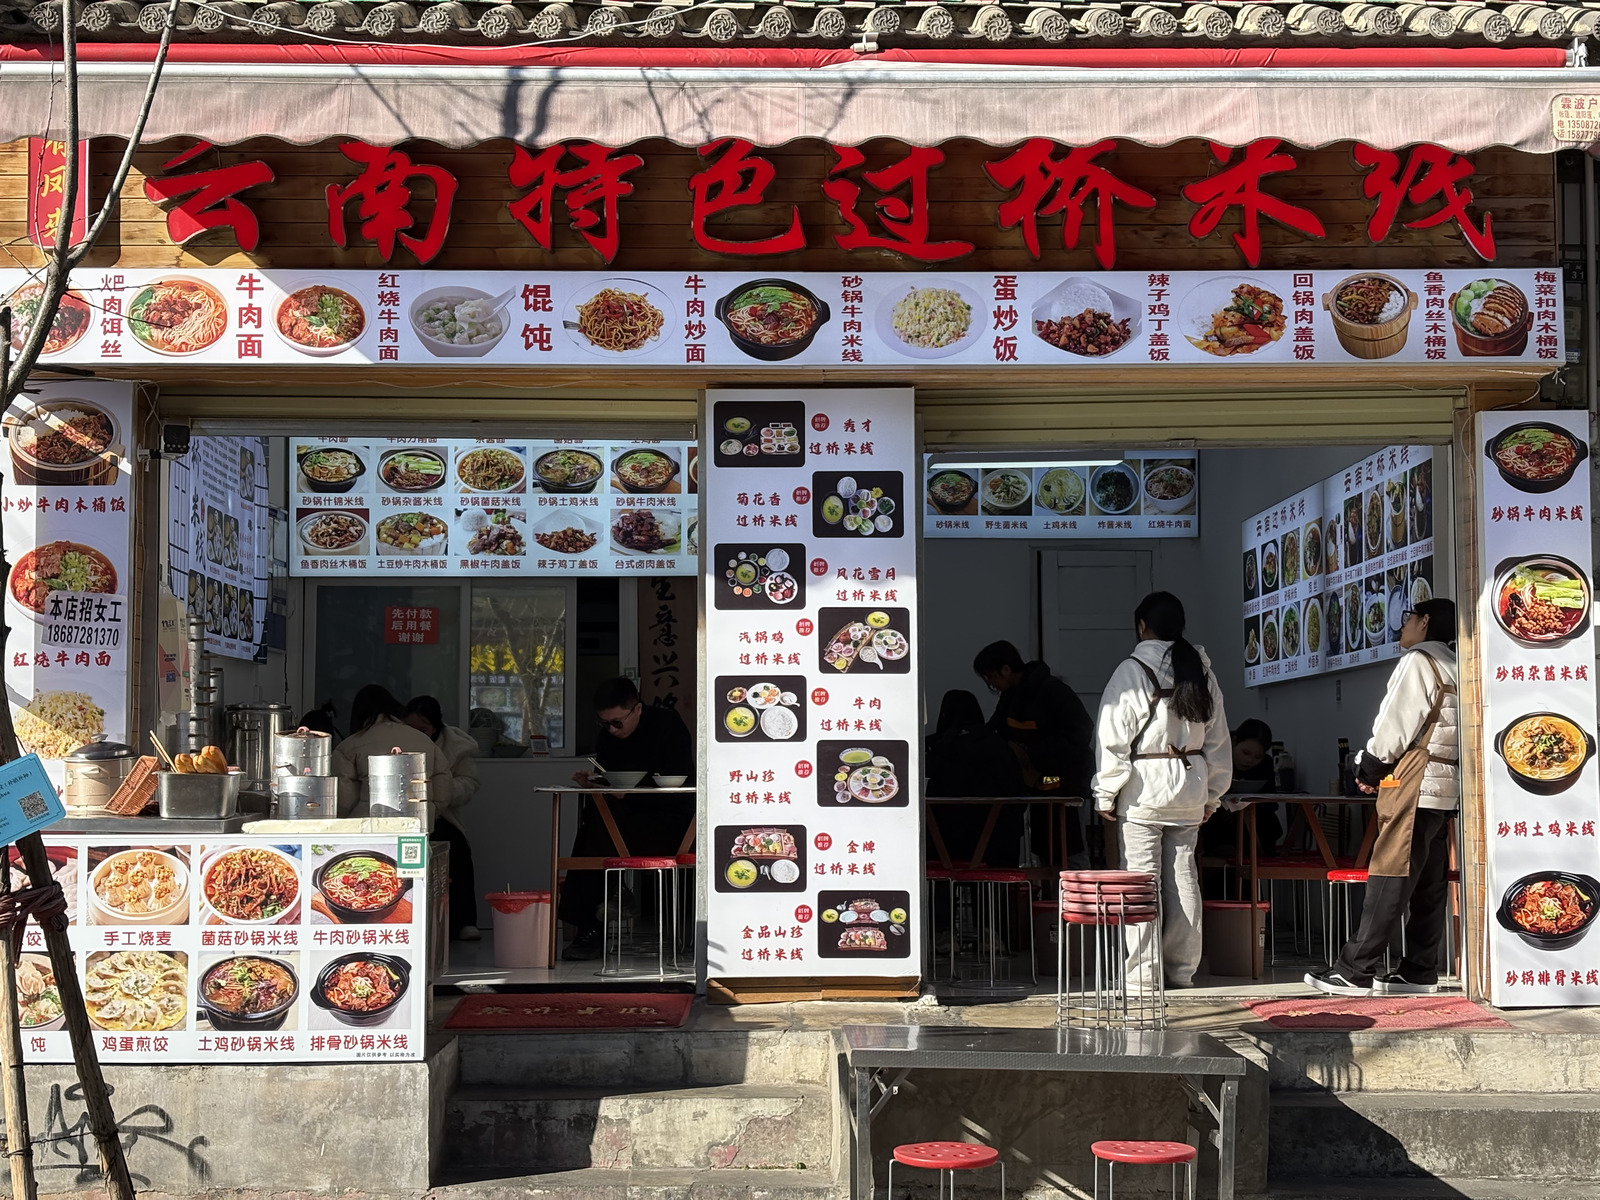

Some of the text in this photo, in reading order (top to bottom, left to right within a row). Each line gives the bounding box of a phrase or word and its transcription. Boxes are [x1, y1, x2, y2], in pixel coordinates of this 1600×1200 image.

[143, 138, 1497, 269] 云南特色过桥米线
[235, 273, 265, 360] 牛肉面
[377, 272, 400, 362] 红烧牛肉面
[520, 284, 553, 352] 馄饨
[684, 275, 706, 363] 牛肉炒面
[841, 276, 864, 362] 砂锅牛肉米线
[993, 275, 1019, 363] 蛋炒饭
[1147, 273, 1171, 362] 辣子鸡丁盖饭
[1293, 273, 1316, 361] 回锅肉盖饭
[1423, 271, 1447, 361] 鱼香肉丝木桶饭
[1534, 271, 1559, 360] 梅菜扣肉木桶饭
[843, 418, 872, 433] 秀才
[809, 441, 874, 456] 过桥米线
[1, 496, 126, 513] 小炒牛肉木桶饭
[302, 496, 364, 506] 砂锅什锦米线
[381, 496, 443, 506] 砂锅杂酱米线
[460, 496, 521, 507] 砂锅菌菇米线
[538, 496, 599, 507] 砂锅土鸡米线
[616, 496, 676, 507] 砂锅牛肉米线
[736, 492, 781, 506] 菊花香
[1491, 504, 1583, 522] 砂锅牛肉米线
[736, 514, 798, 528] 过桥米线
[936, 520, 970, 529] 砂锅米线
[1043, 521, 1077, 530] 土鸡米线
[1148, 519, 1192, 529] 红烧牛肉面
[300, 559, 367, 570] 鱼香肉丝木桶饭
[377, 559, 447, 570] 土豆炒牛肉木桶饭
[460, 559, 521, 570] 黑椒牛肉盖饭
[537, 559, 598, 569] 辣子鸡丁盖饭
[615, 559, 676, 569] 台式卤肉盖饭
[836, 567, 896, 580] 风花雪月
[836, 589, 898, 602] 过桥米线
[50, 597, 122, 623] 本店招女工
[391, 608, 432, 619] 先付款
[391, 620, 432, 631] 后用餐
[47, 623, 119, 647] 18687281370
[398, 632, 425, 643] 谢谢
[739, 631, 784, 644] 汽锅鸡
[13, 650, 111, 667] 红烧牛肉面
[739, 652, 801, 665] 过桥米线
[1496, 664, 1588, 682] 砂锅杂酱米线
[853, 697, 882, 710] 牛肉
[820, 718, 883, 732] 过桥米线
[729, 769, 775, 783] 野山珍
[730, 791, 792, 804] 过桥米线
[1496, 820, 1596, 838] 砂锅土鸡米线
[846, 840, 876, 854] 金牌
[814, 861, 877, 876] 过桥米线
[103, 930, 172, 947] 手工烧麦
[201, 930, 298, 946] 菌菇砂锅米线
[313, 929, 410, 945] 牛肉砂锅米线
[741, 925, 804, 939] 金品山珍
[741, 948, 804, 961] 过桥米线
[1505, 969, 1600, 987] 砂锅排骨米线
[102, 1036, 169, 1053] 鸡蛋煎饺
[198, 1036, 295, 1052] 土鸡砂锅米线
[310, 1034, 408, 1051] 排骨砂锅米线
